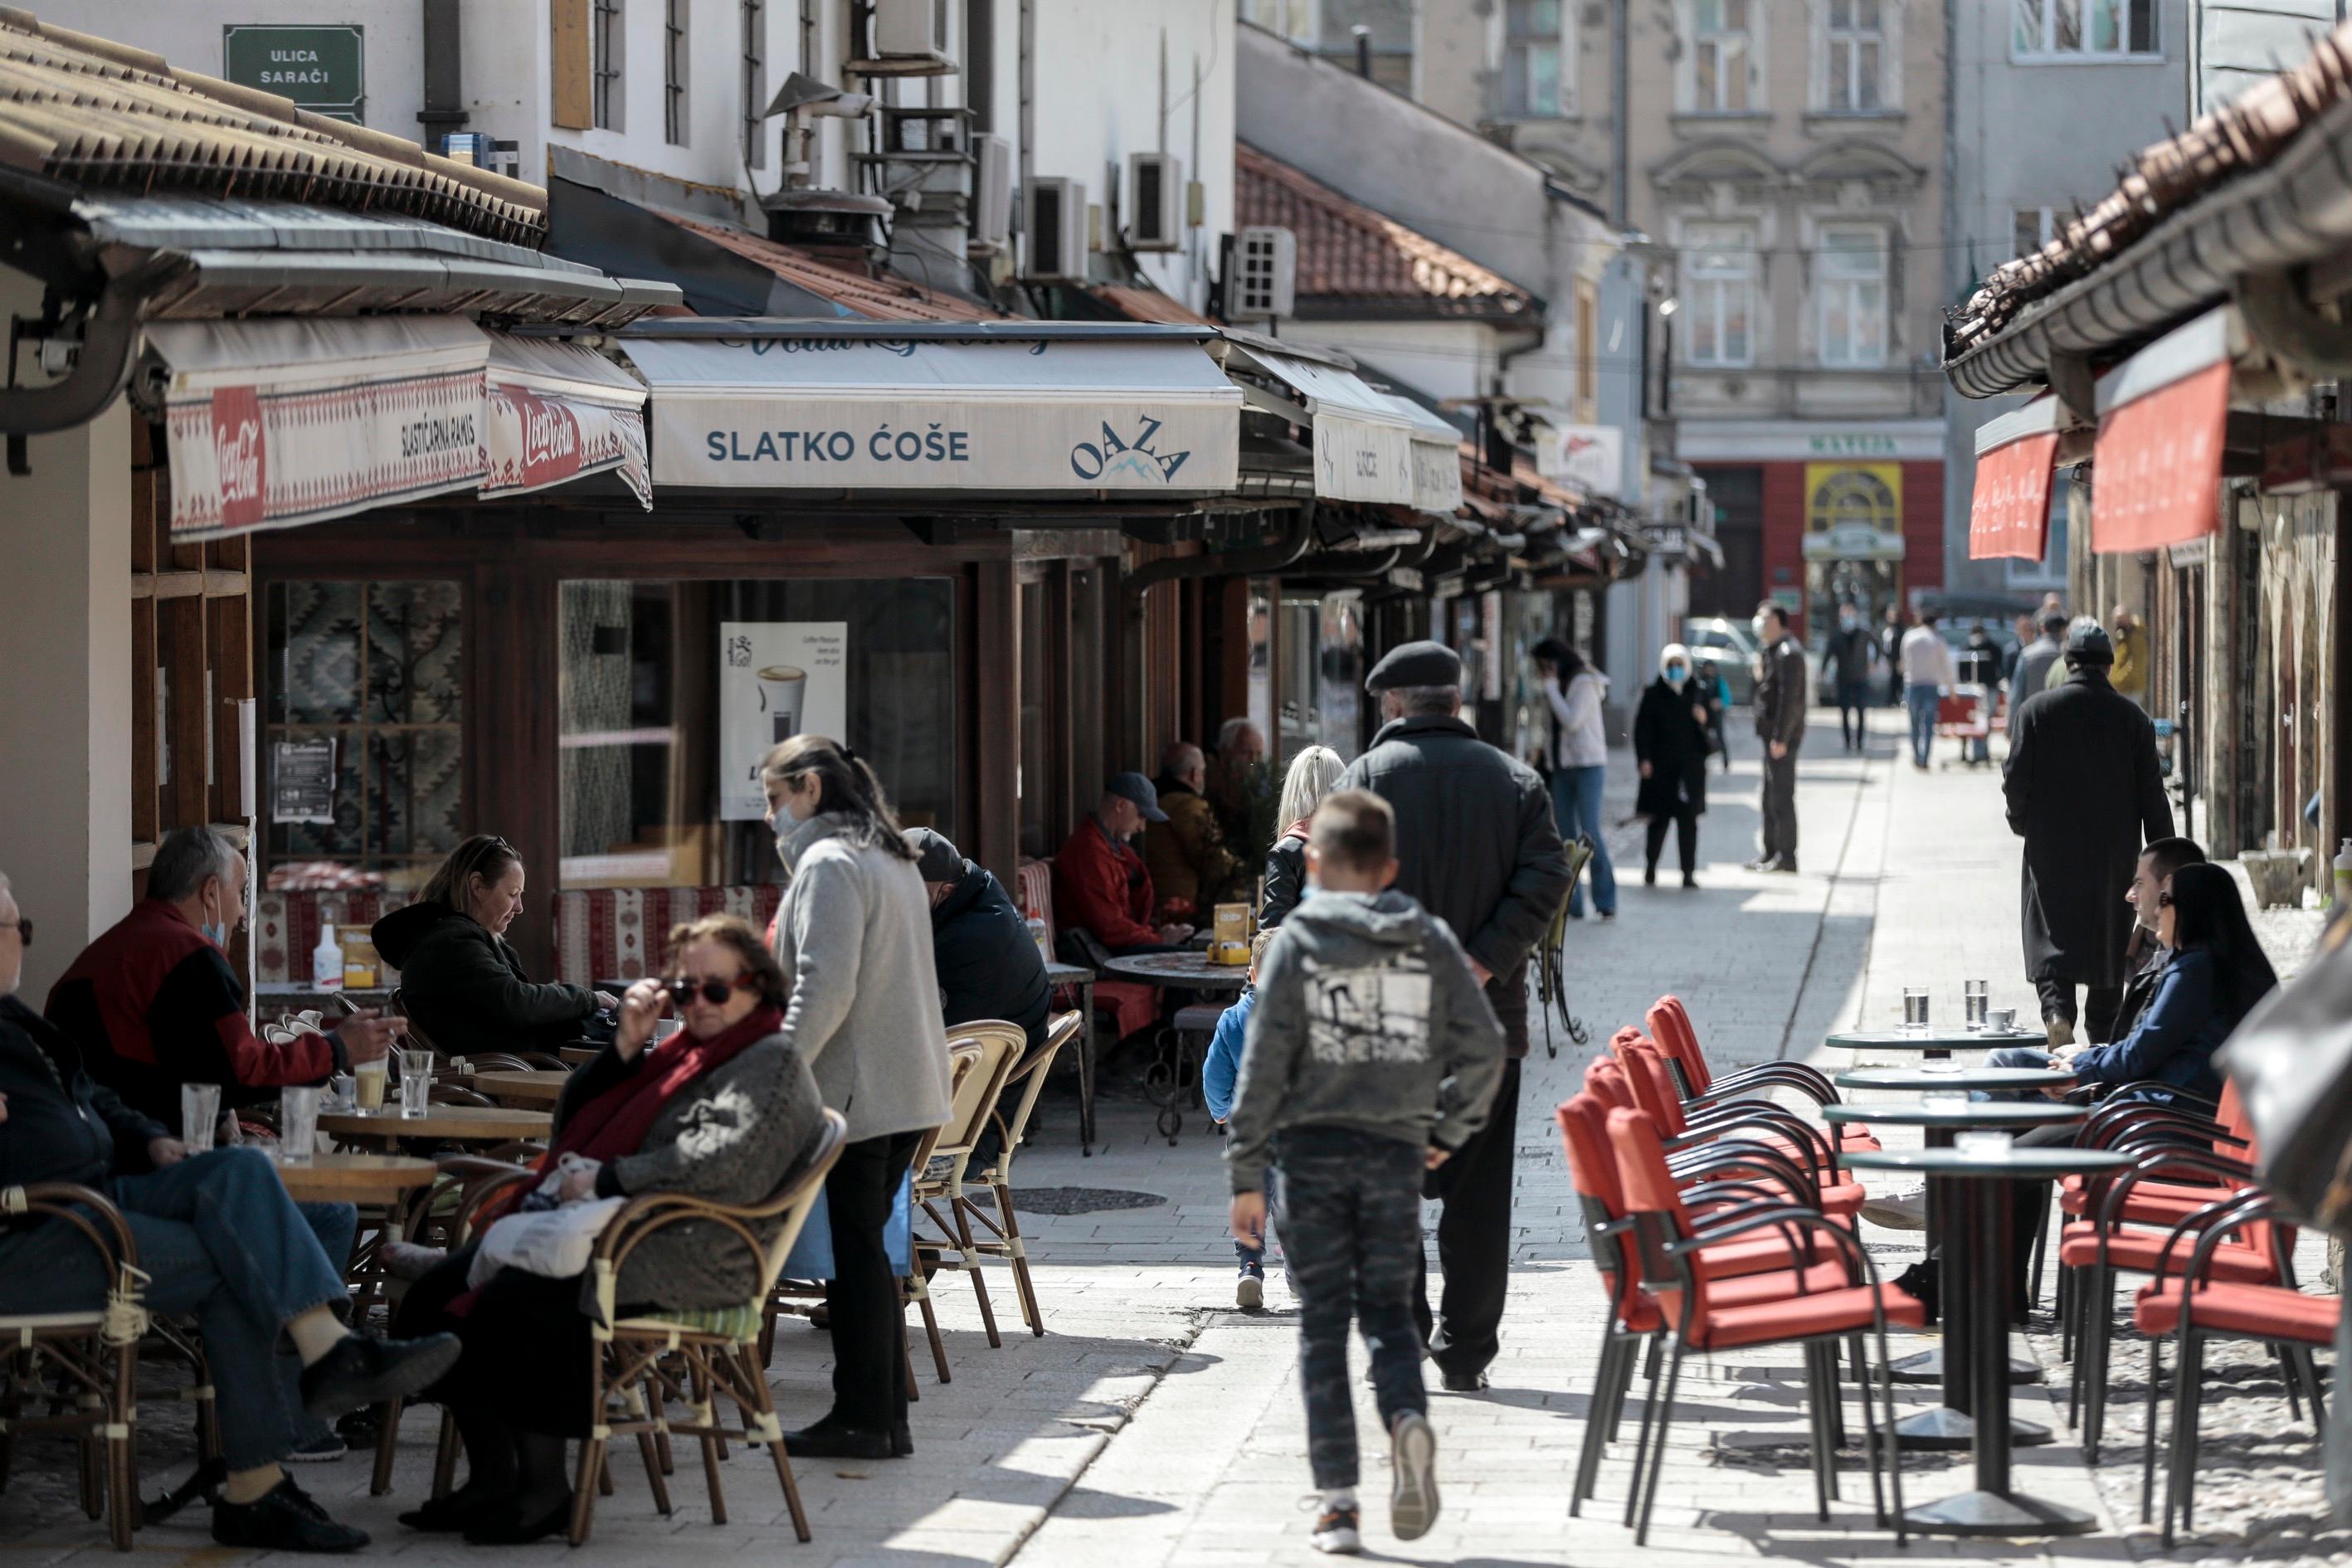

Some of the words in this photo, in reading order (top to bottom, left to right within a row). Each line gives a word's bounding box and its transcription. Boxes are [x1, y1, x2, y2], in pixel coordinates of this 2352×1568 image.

[271, 50, 319, 62] ULICA
[261, 68, 329, 84] SARAČI
[450, 413, 475, 449] RAMIS
[707, 431, 855, 461] SLATKO
[869, 423, 969, 461] ĆOŠE
[1071, 414, 1191, 484] OAZA
